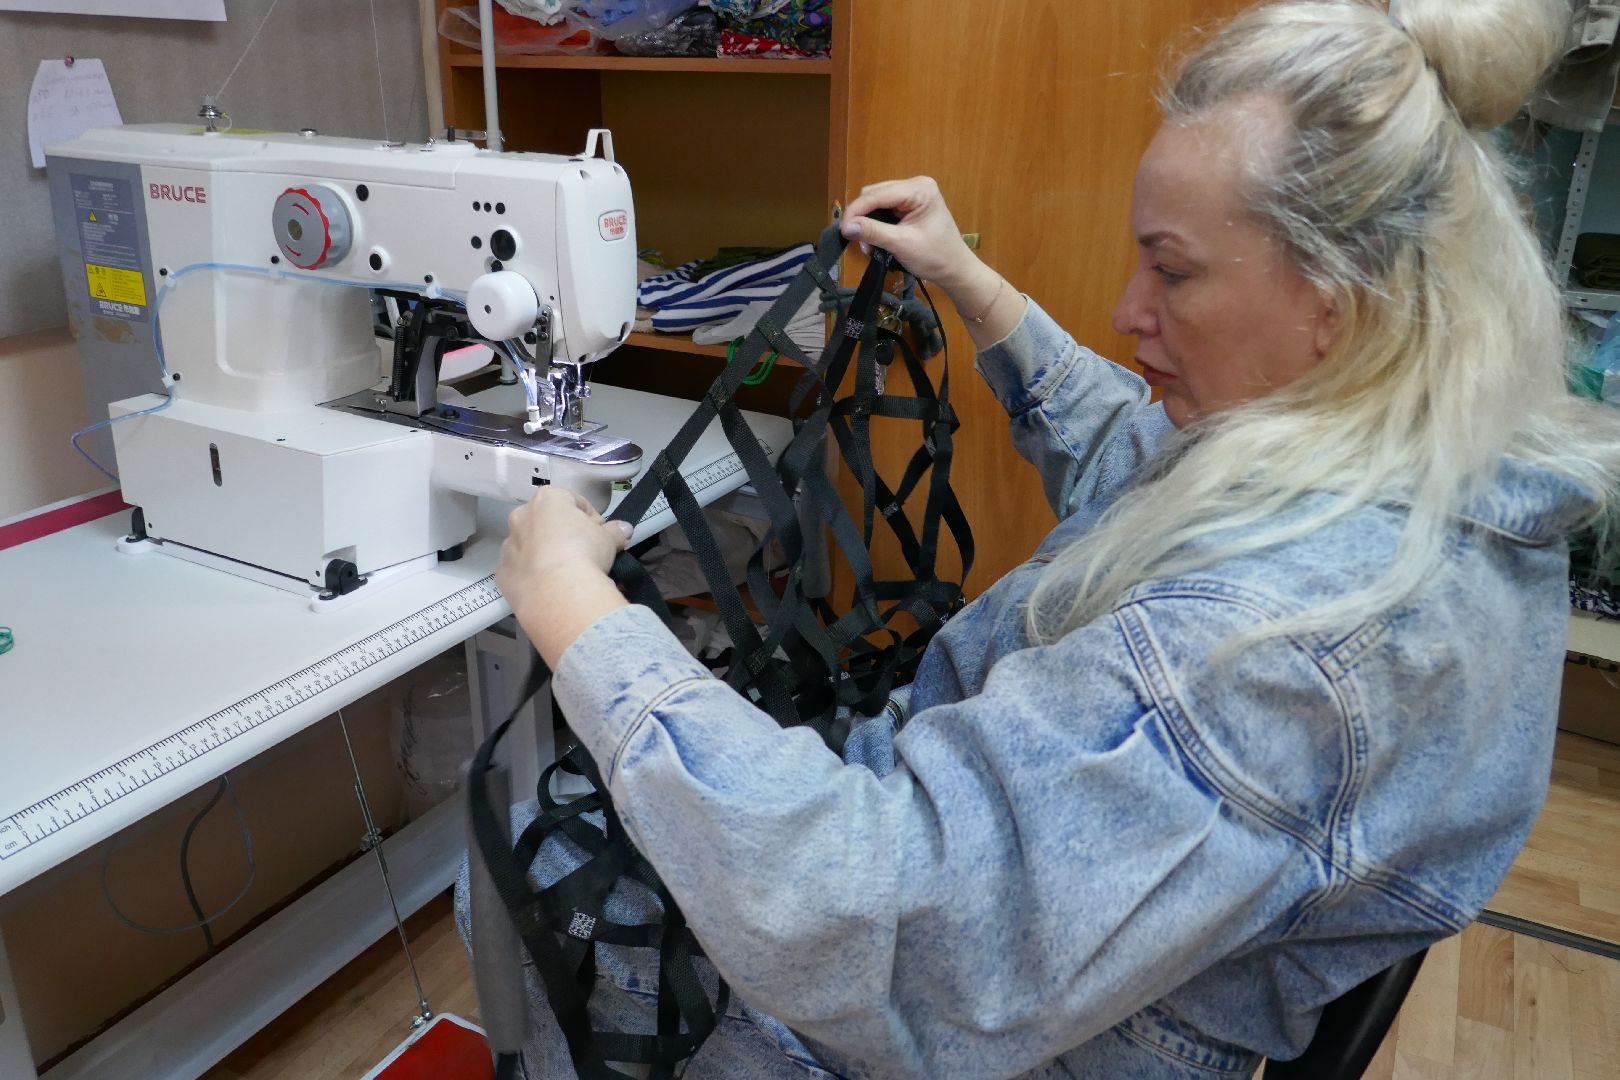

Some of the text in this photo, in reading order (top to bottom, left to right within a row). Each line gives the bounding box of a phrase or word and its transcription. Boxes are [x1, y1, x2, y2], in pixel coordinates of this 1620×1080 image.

[150, 183, 206, 204] BRUCE
[604, 215, 627, 228] BRUCE
[99, 300, 123, 312] BRUCE
[0, 824, 12, 834] ch
[4, 840, 18, 850] cm
